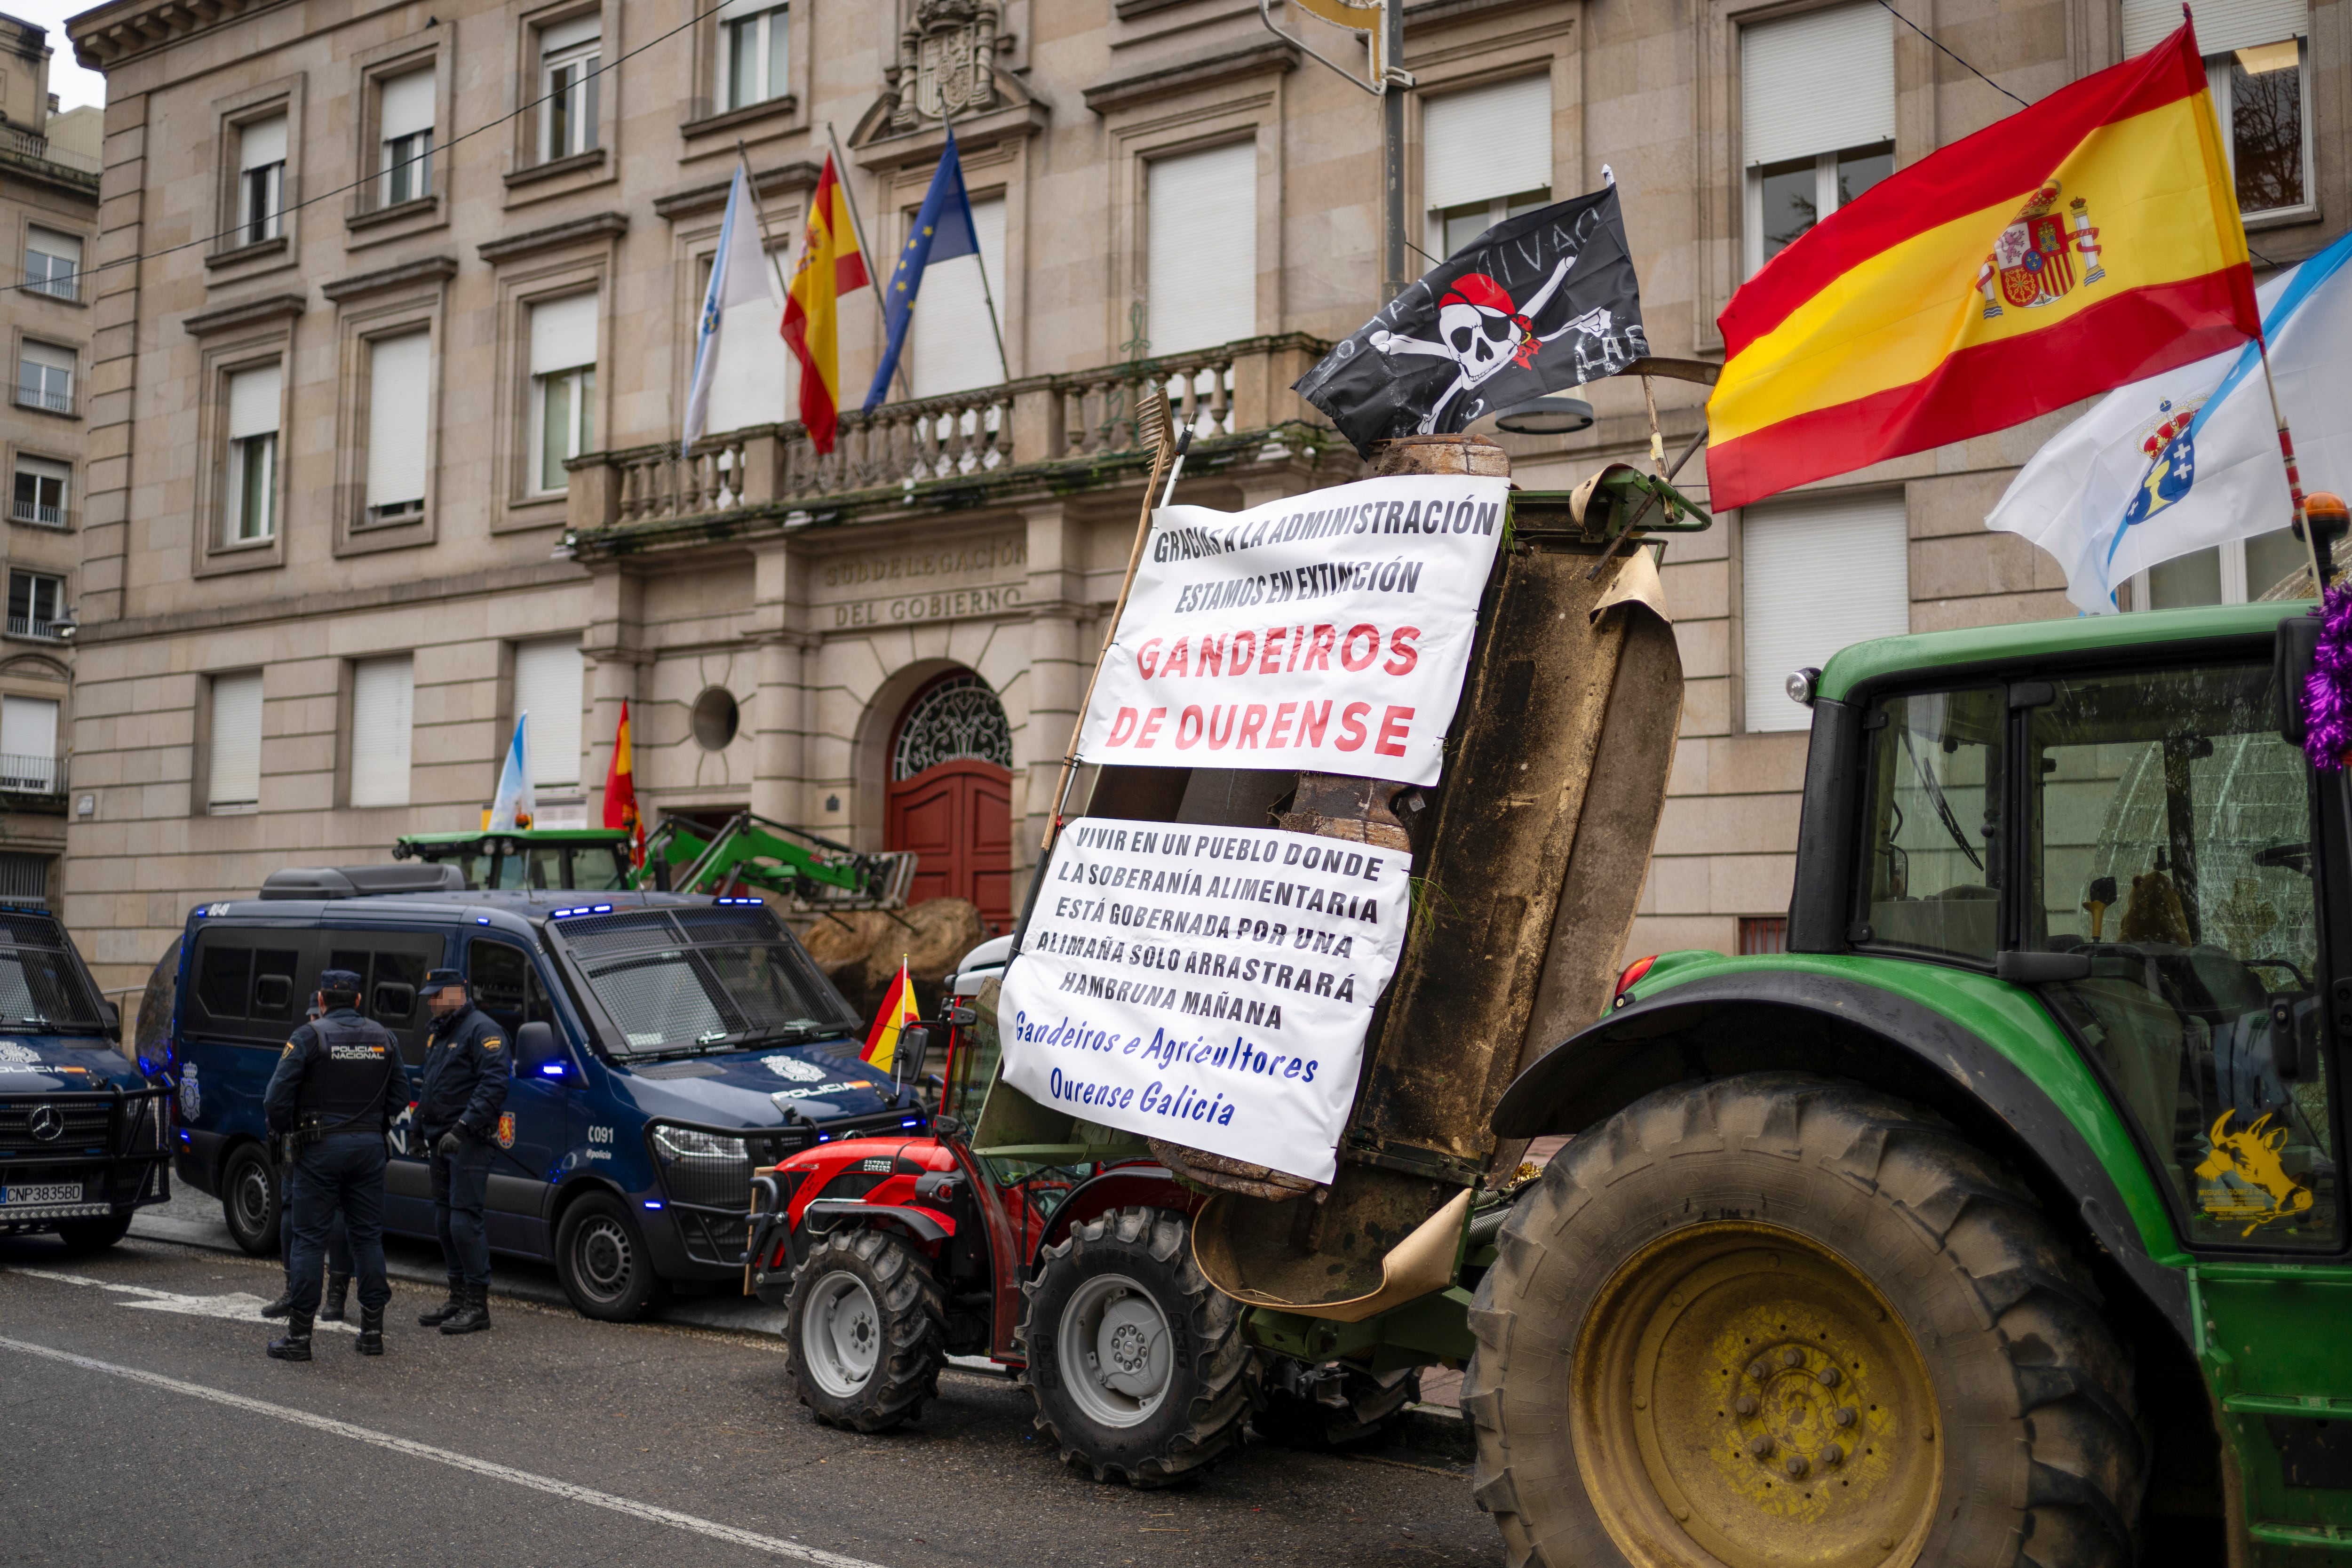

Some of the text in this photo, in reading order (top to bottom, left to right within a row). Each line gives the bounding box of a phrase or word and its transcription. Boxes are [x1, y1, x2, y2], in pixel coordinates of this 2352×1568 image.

[1154, 495, 1497, 563] GRACIAS A LA ADMINISTRACIÓN
[835, 587, 1021, 626] DEL GOBIERNO
[1175, 555, 1423, 613] ESTAMOS EN EXTINCIÓN
[1137, 623, 1421, 680] GANDEIROS
[1105, 700, 1415, 757] DE OURENSE
[1077, 828, 1383, 882] VIVIR EN UN PUEBLO DONDE
[1058, 862, 1377, 924] LA SOBERANÍA ALIMENTARIA
[1056, 897, 1352, 958] ESTÁ GOBERNADA POR UNA
[1036, 931, 1356, 1003] ALIMAÑA SOLO ARRASTRARÁ
[1059, 972, 1281, 1029] HAMBRUNA MAÑANA
[1016, 1010, 1318, 1082] Gandeiros e Agricultores
[771, 1082, 858, 1101] POLICIA
[1051, 1067, 1235, 1126] Ourense Galicia
[7, 1186, 80, 1202] CNP3835BD
